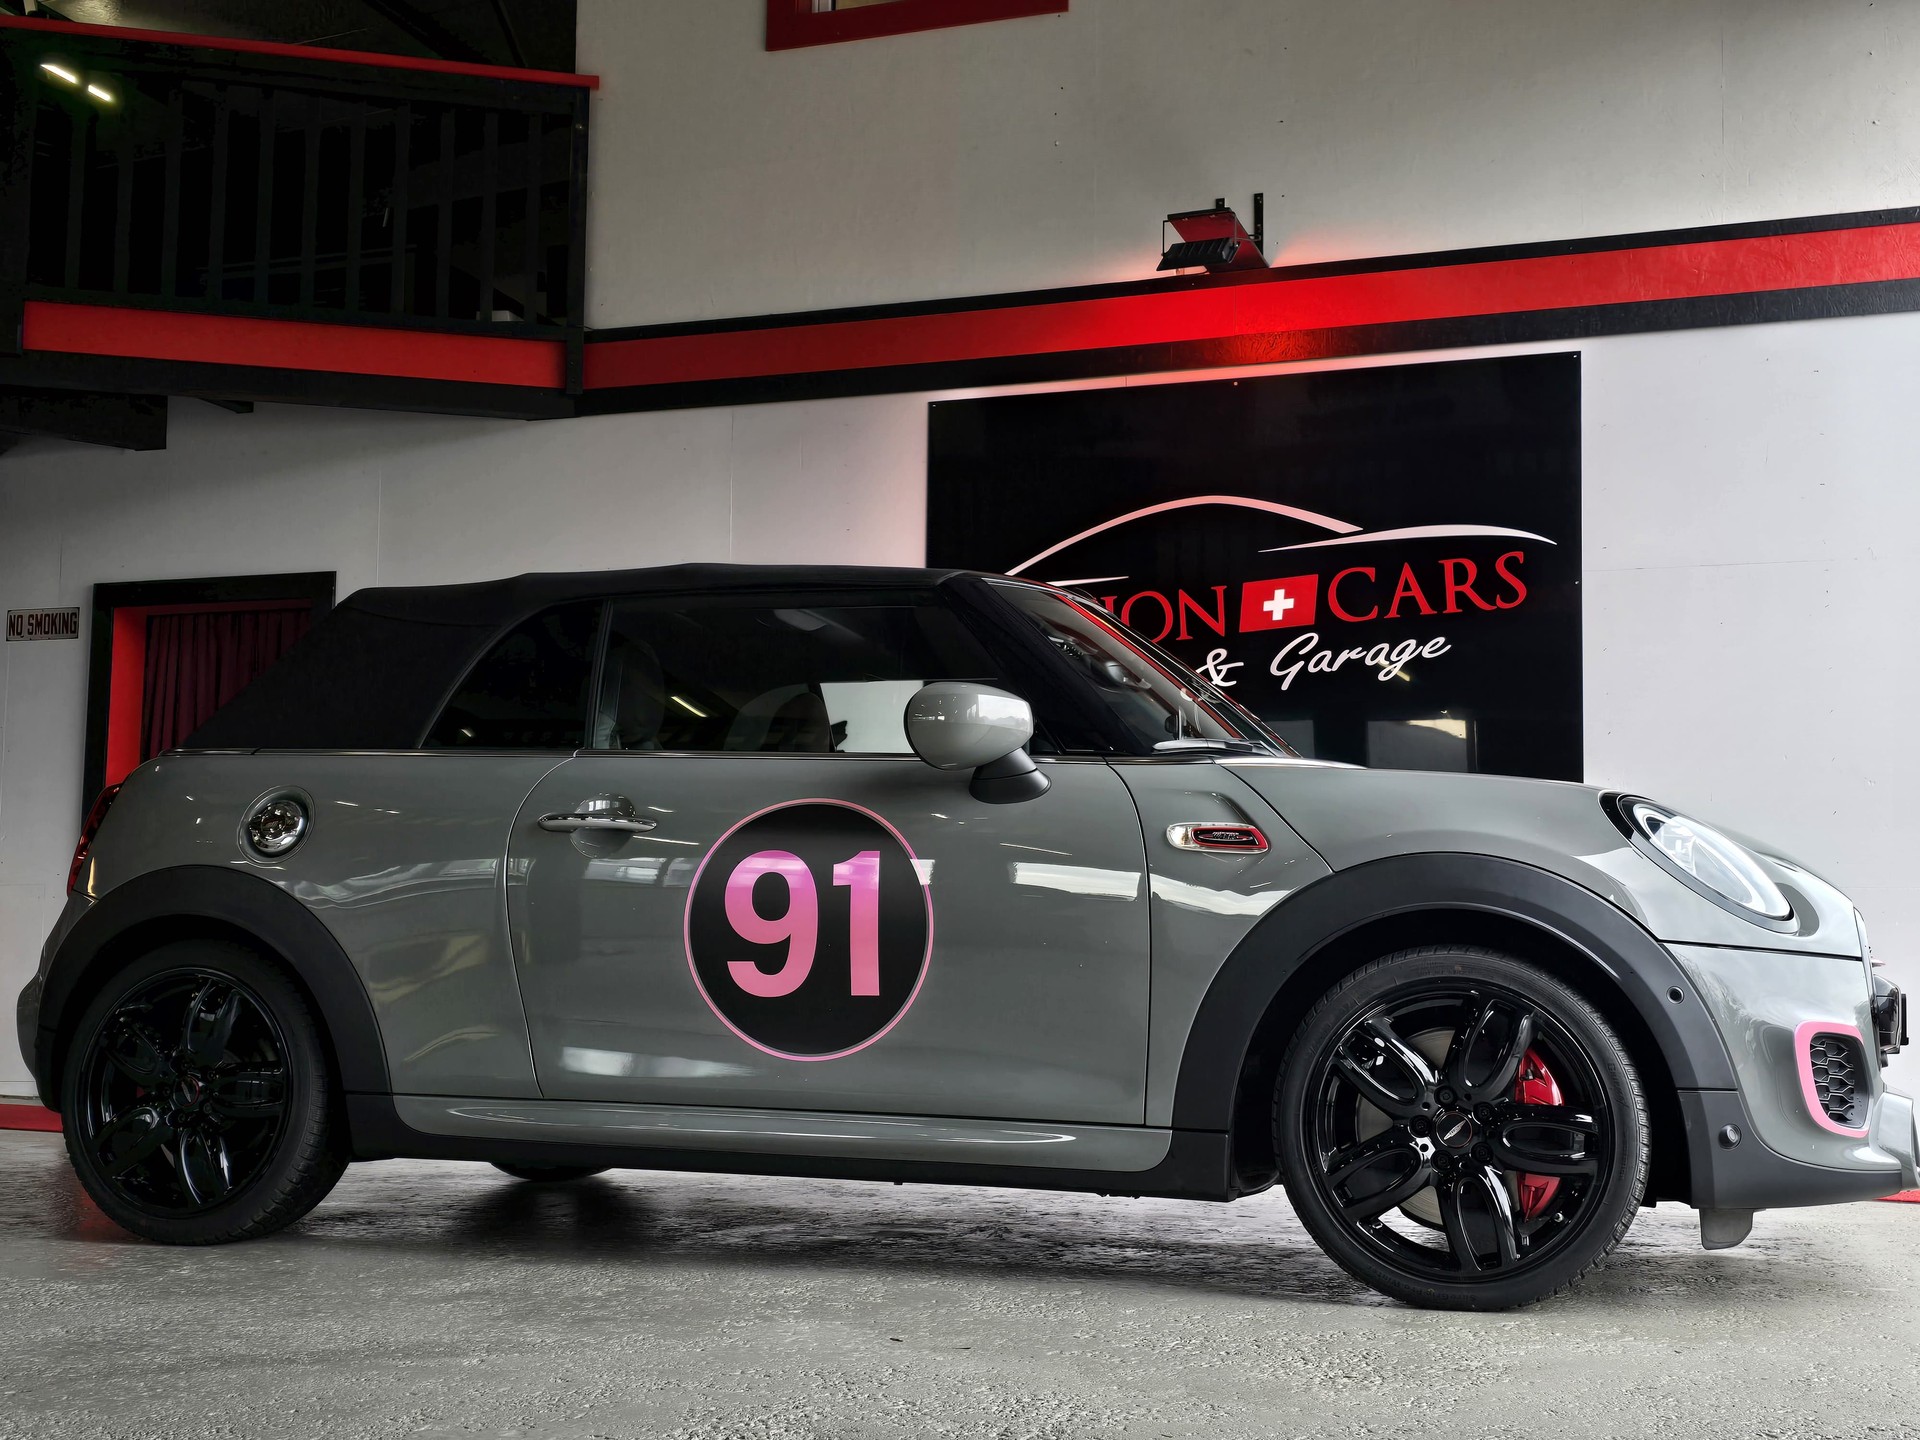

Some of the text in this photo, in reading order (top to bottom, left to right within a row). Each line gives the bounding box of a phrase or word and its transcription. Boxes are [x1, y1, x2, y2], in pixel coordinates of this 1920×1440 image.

[1328, 551, 1527, 622] CARS
[9, 612, 77, 636] NO SMOKING
[1196, 632, 1451, 691] & Garage
[724, 850, 880, 997] 91
